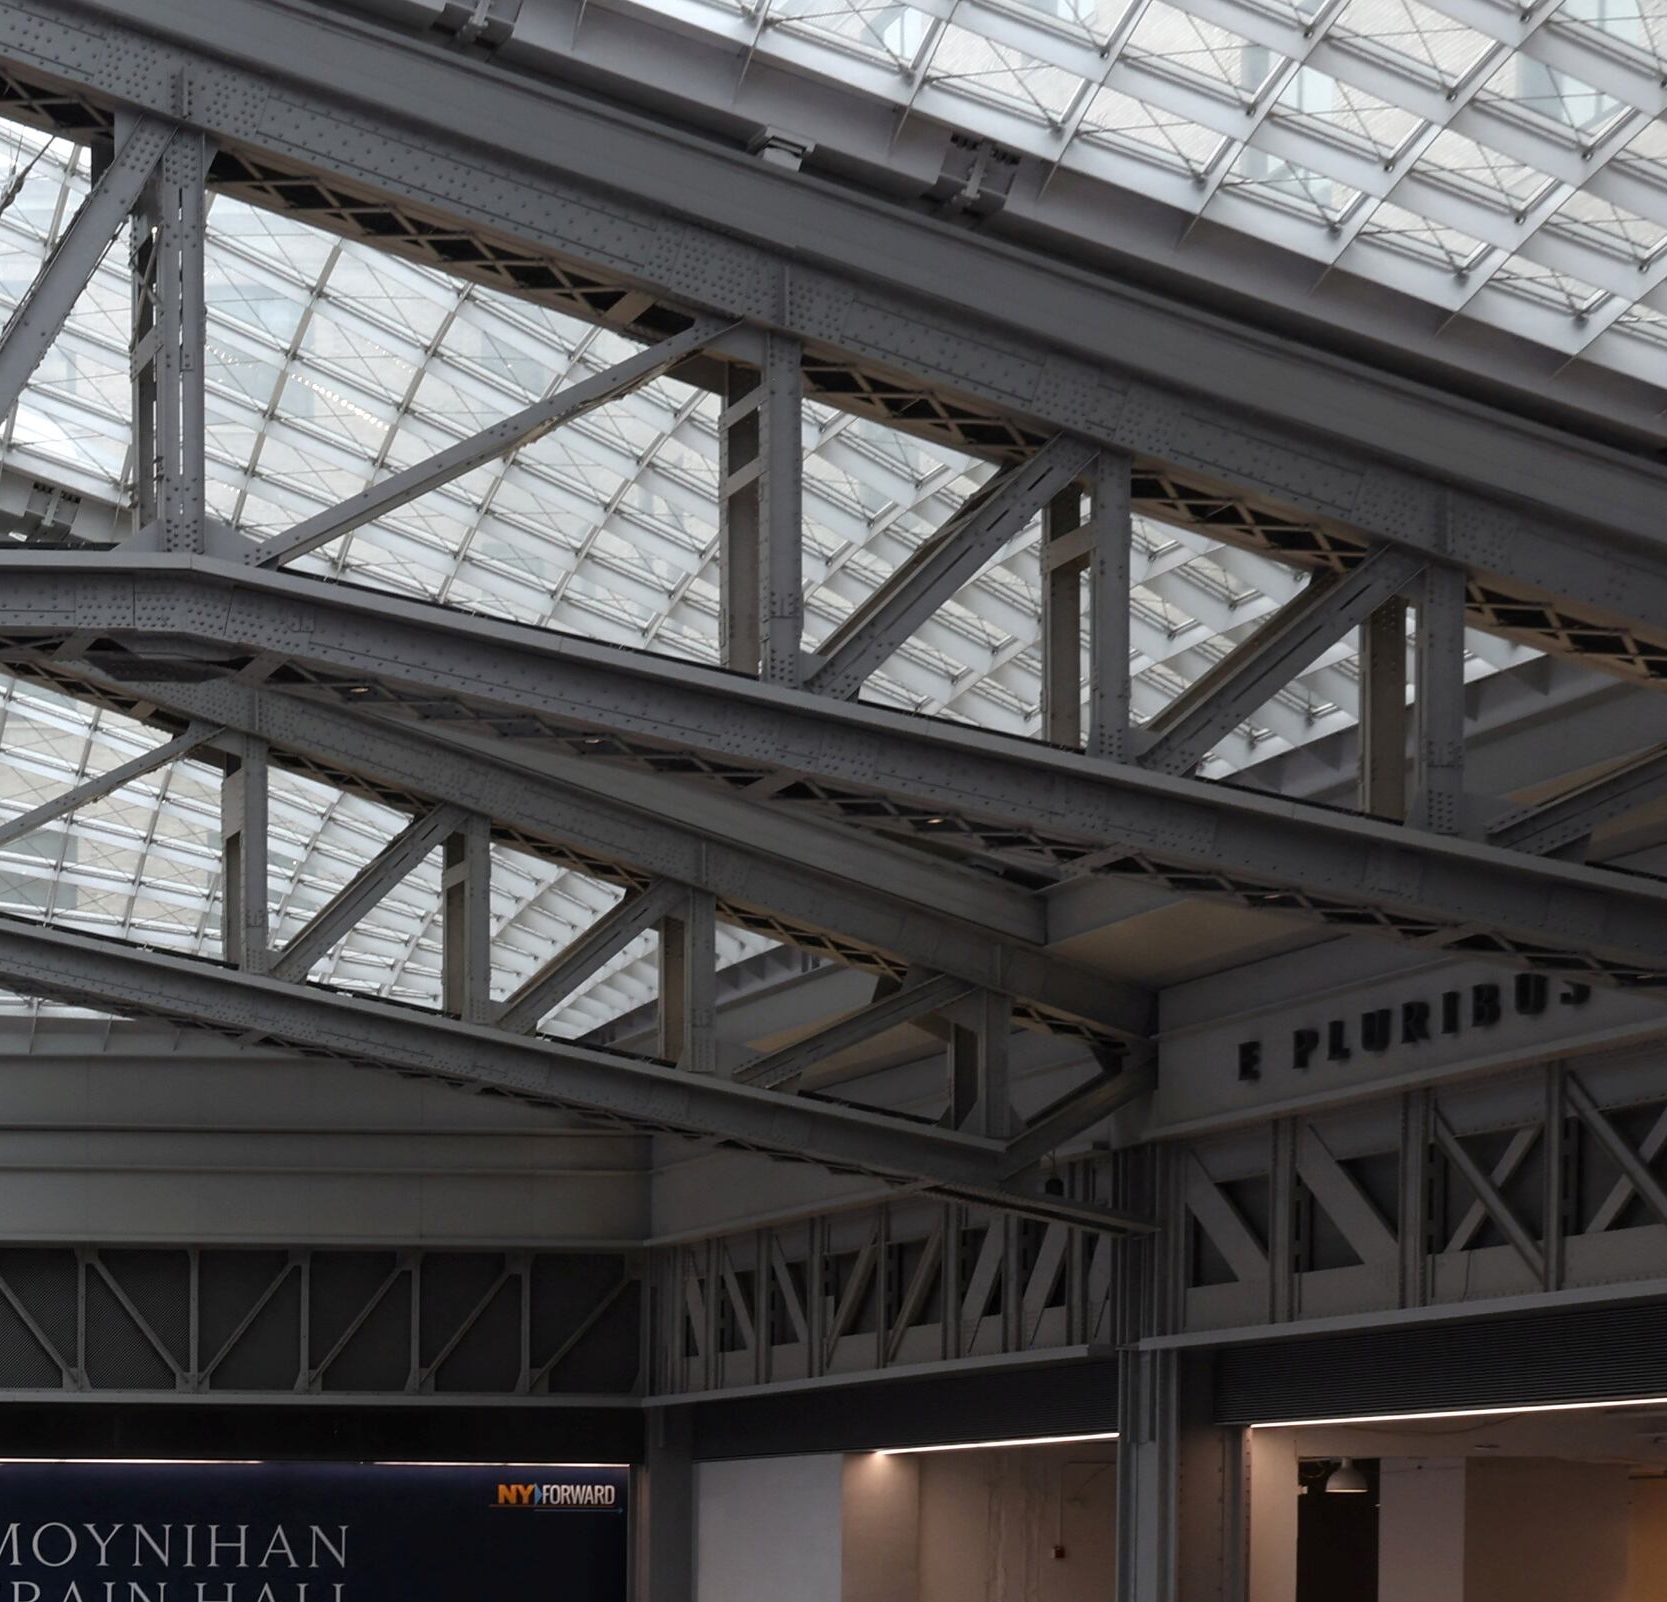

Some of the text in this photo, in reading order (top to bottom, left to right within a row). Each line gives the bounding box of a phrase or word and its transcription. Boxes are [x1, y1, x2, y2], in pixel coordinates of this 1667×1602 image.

[1238, 1040, 1262, 1081] E
[497, 1484, 616, 1505] NY FORWARD
